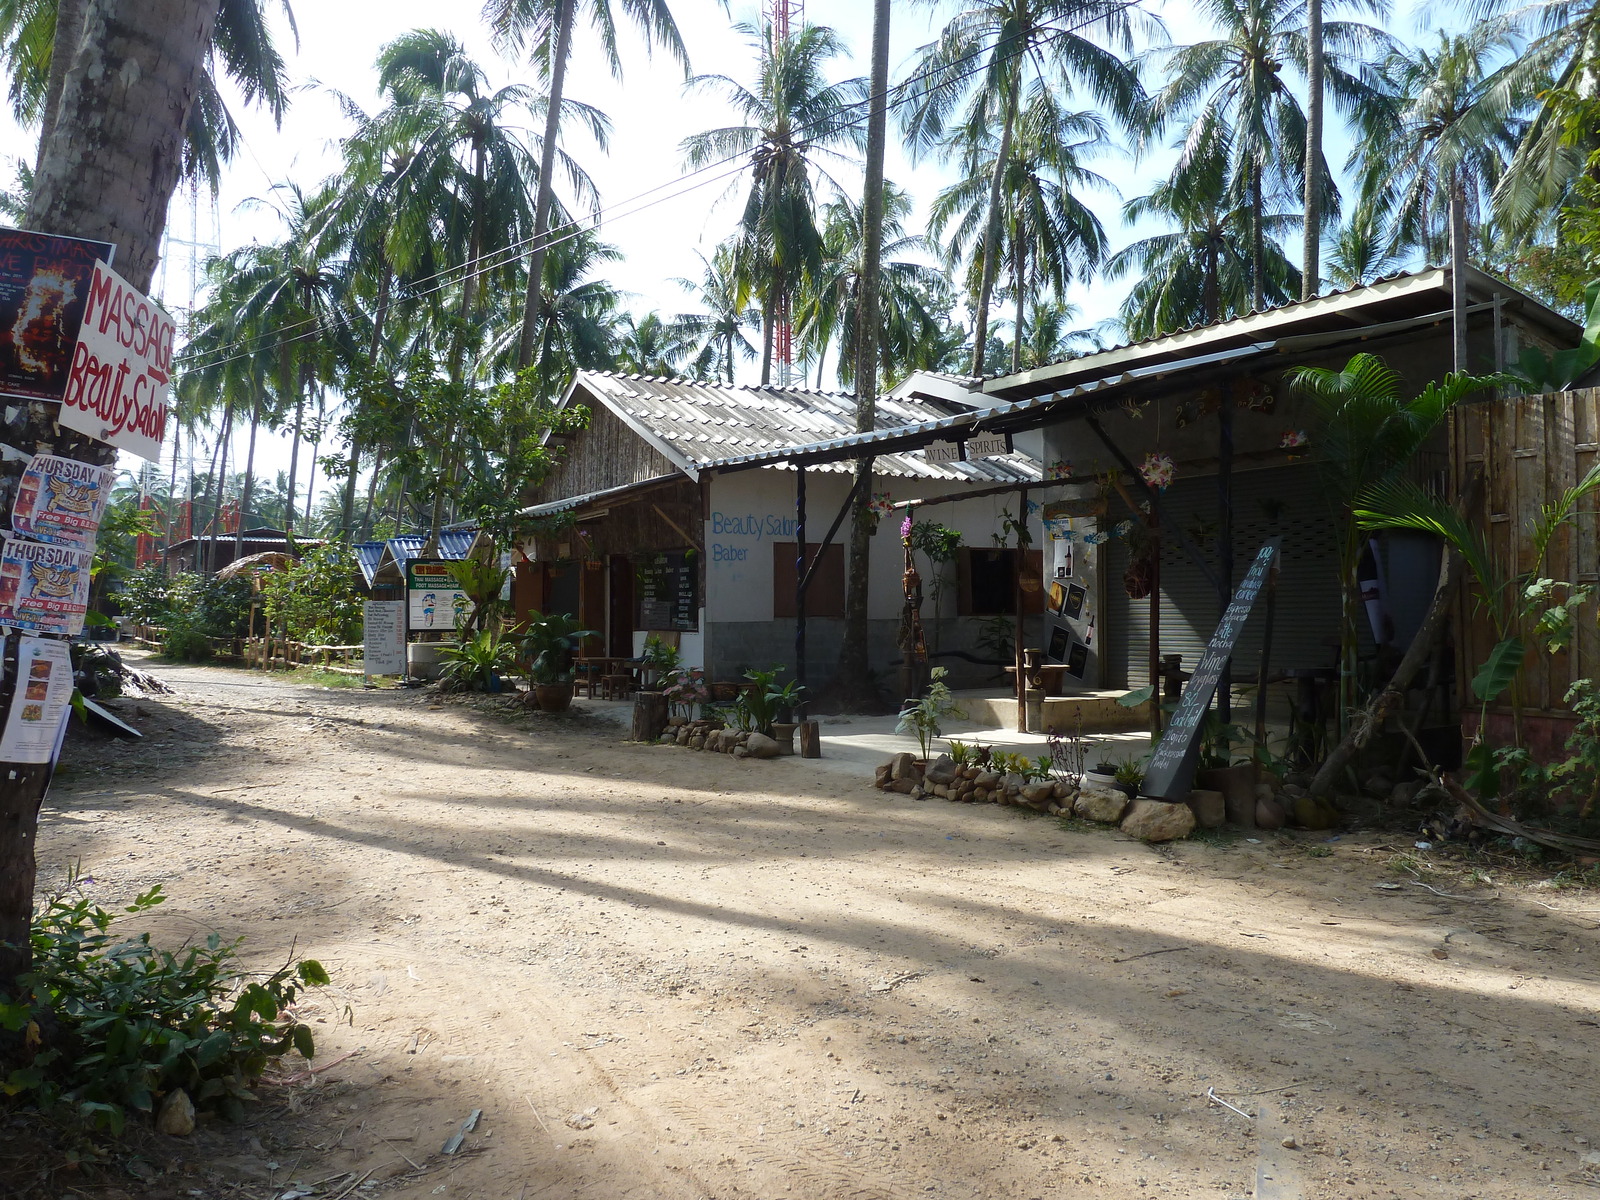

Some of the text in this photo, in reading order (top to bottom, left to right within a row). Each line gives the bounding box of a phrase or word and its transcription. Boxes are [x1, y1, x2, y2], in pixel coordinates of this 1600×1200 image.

[85, 267, 176, 376] MASSAGE
[926, 439, 1007, 461] WINE SPIRITS
[29, 457, 95, 484] THURSDAY
[37, 511, 61, 522] Free
[64, 514, 79, 527] Big
[712, 511, 798, 541] Beauty Salon
[7, 542, 75, 567] THURSDAY
[712, 543, 749, 562] Baber
[20, 598, 44, 608] Free
[47, 601, 61, 611] Big
[1200, 649, 1227, 670] Wine
